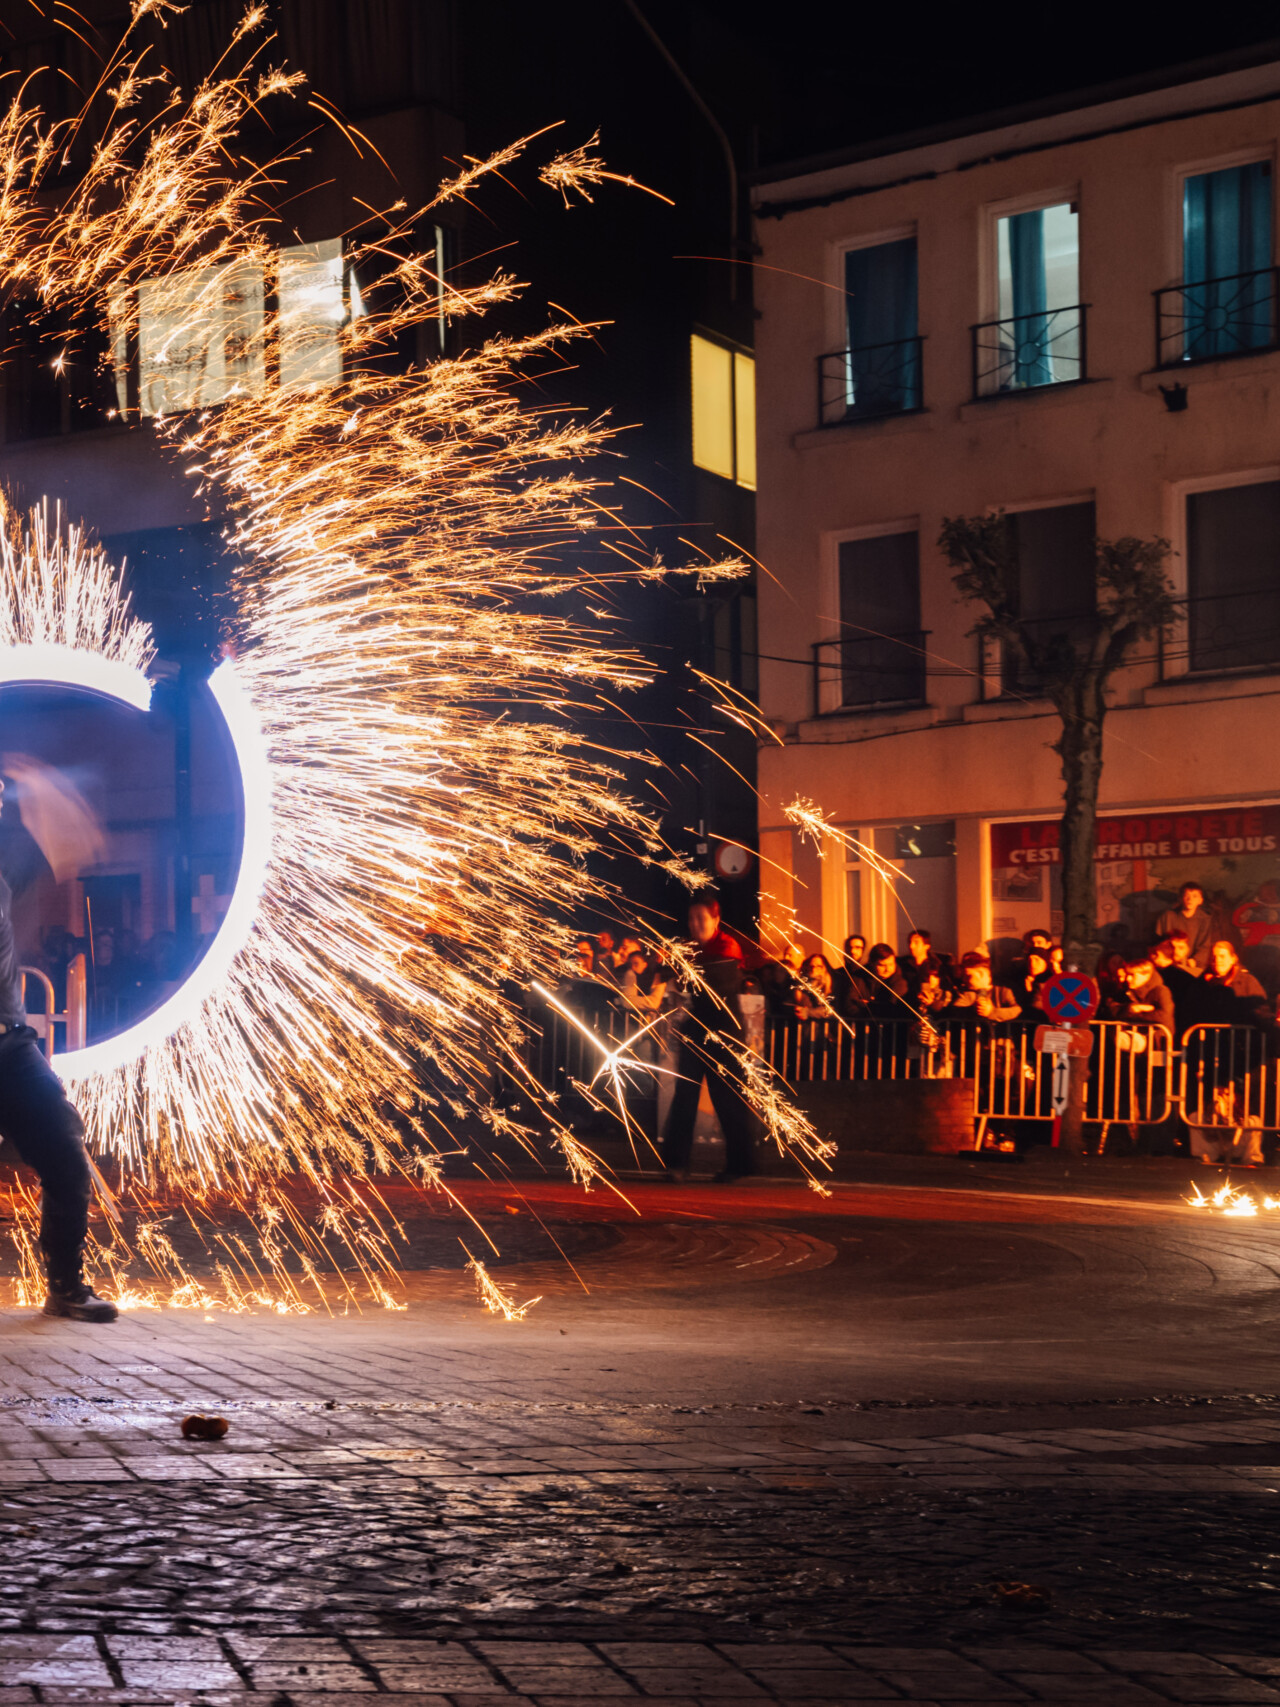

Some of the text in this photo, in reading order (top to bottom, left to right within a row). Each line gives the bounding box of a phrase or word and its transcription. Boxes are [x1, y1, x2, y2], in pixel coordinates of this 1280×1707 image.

[1009, 848, 1060, 864] C'EST
[1179, 839, 1209, 855] DE
[1217, 835, 1276, 852] TOUS
